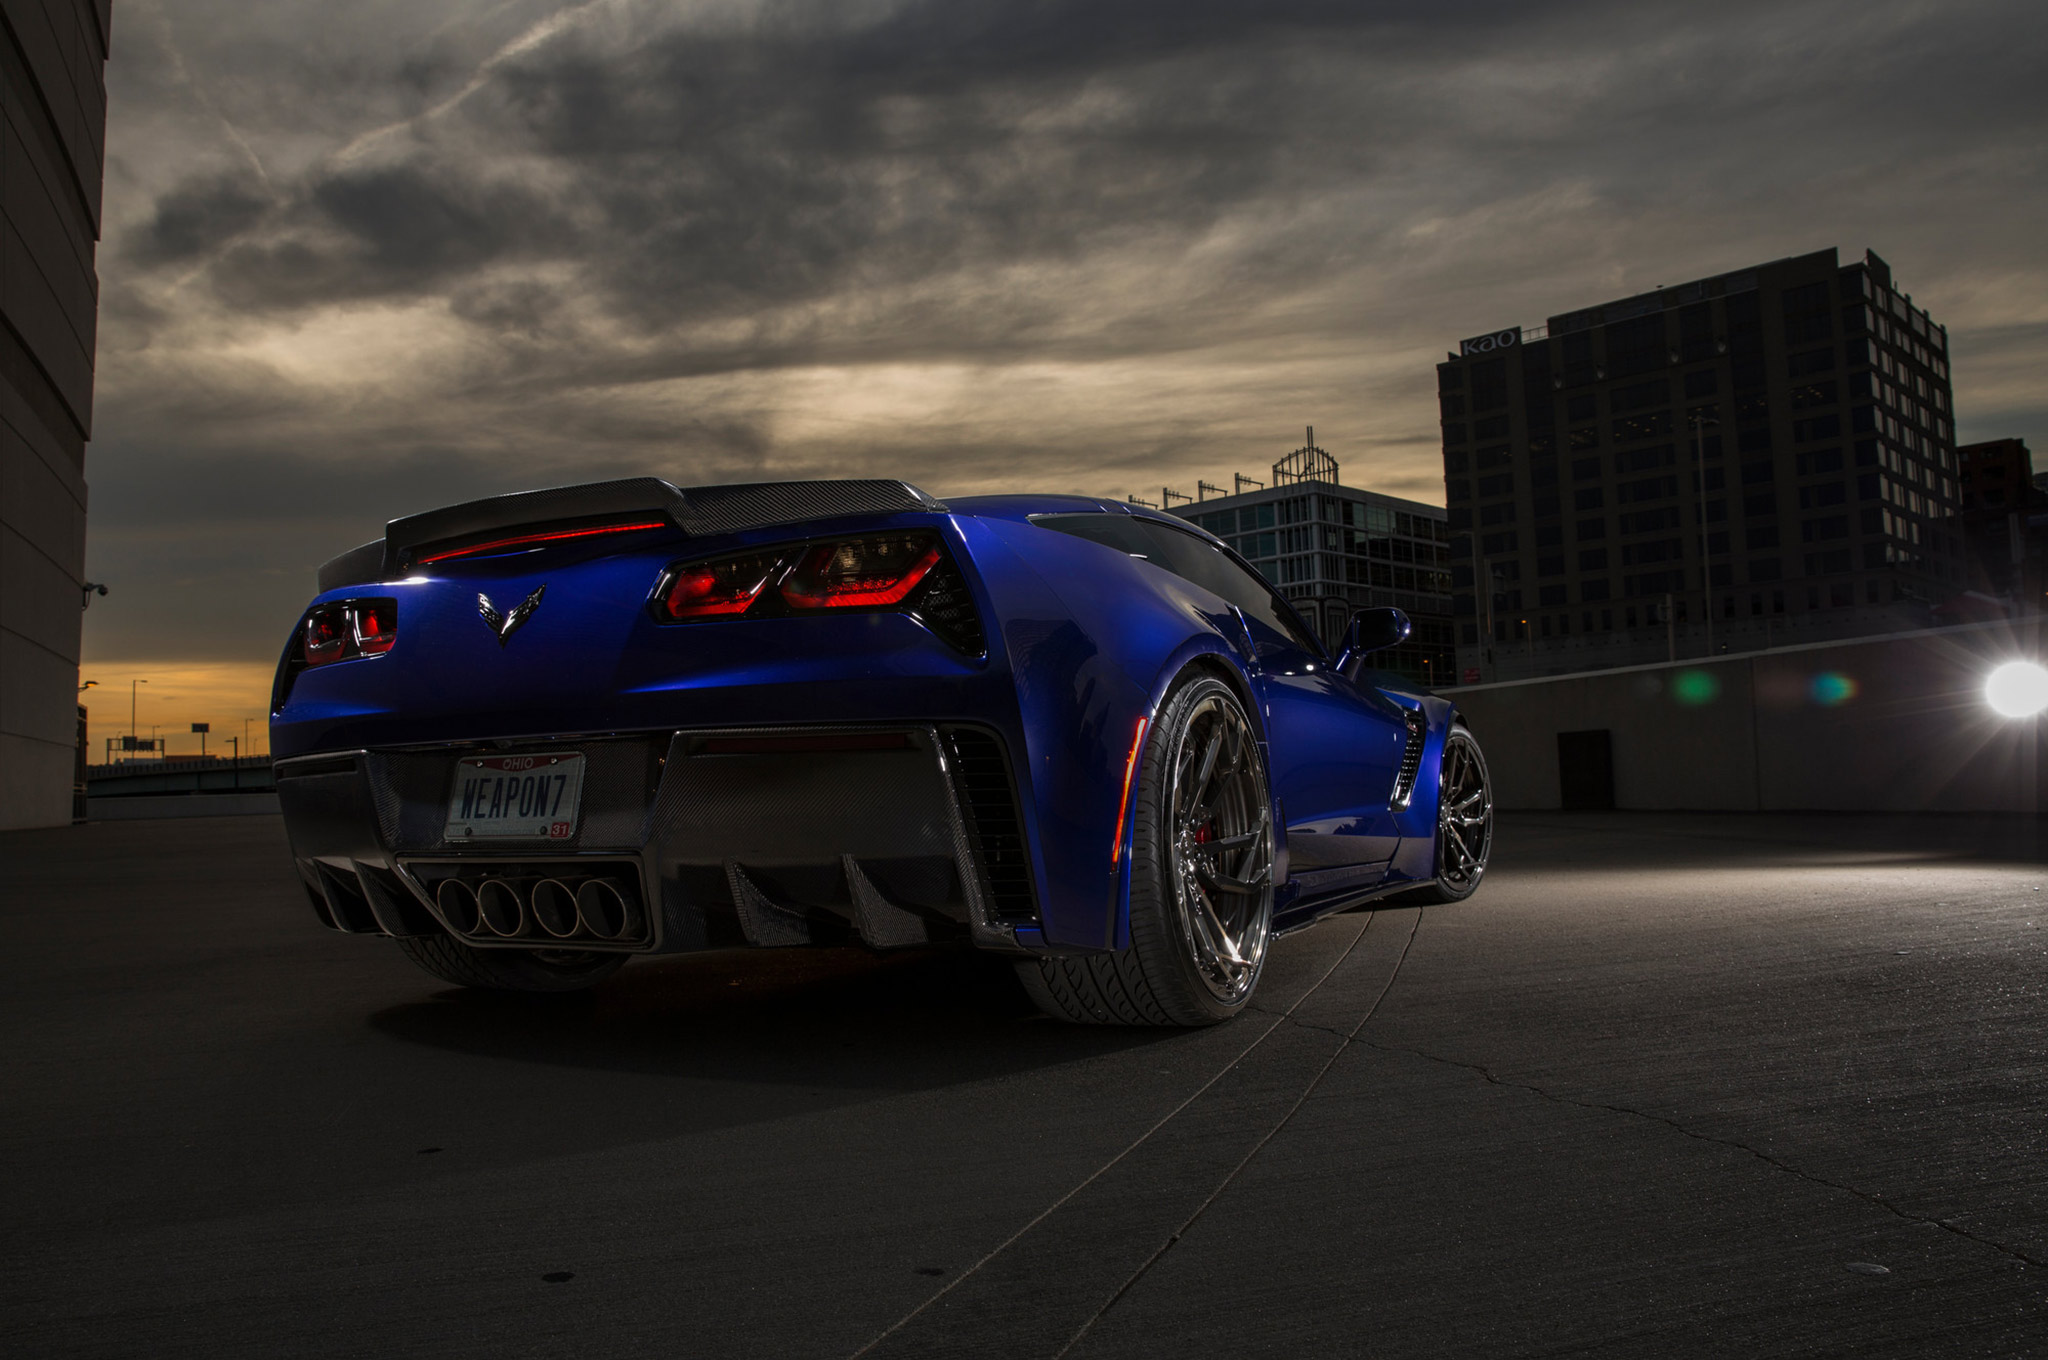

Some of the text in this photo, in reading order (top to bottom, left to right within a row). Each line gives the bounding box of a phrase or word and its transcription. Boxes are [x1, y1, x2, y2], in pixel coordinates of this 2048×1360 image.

[502, 757, 534, 770] OHIO
[460, 775, 567, 819] WEAPON7
[552, 824, 568, 835] 31
